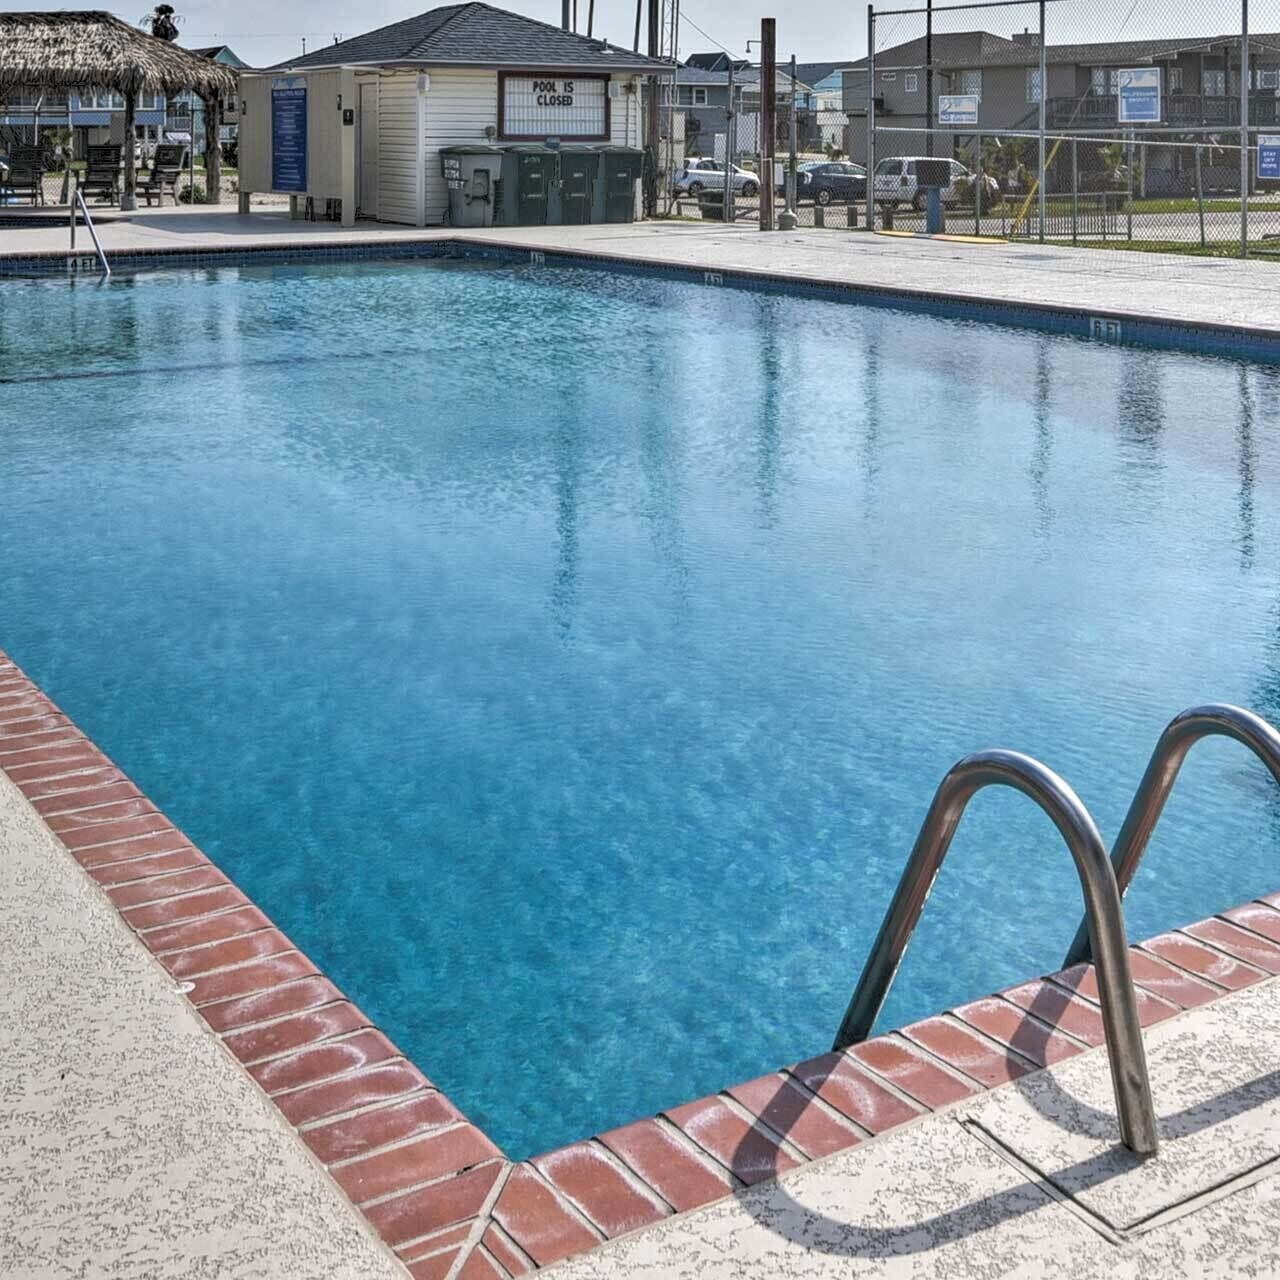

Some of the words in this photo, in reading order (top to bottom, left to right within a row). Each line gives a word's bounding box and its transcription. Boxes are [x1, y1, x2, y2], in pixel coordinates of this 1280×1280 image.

[533, 81, 557, 93] POOL
[564, 81, 574, 93] IS
[537, 95, 573, 106] CLOSED
